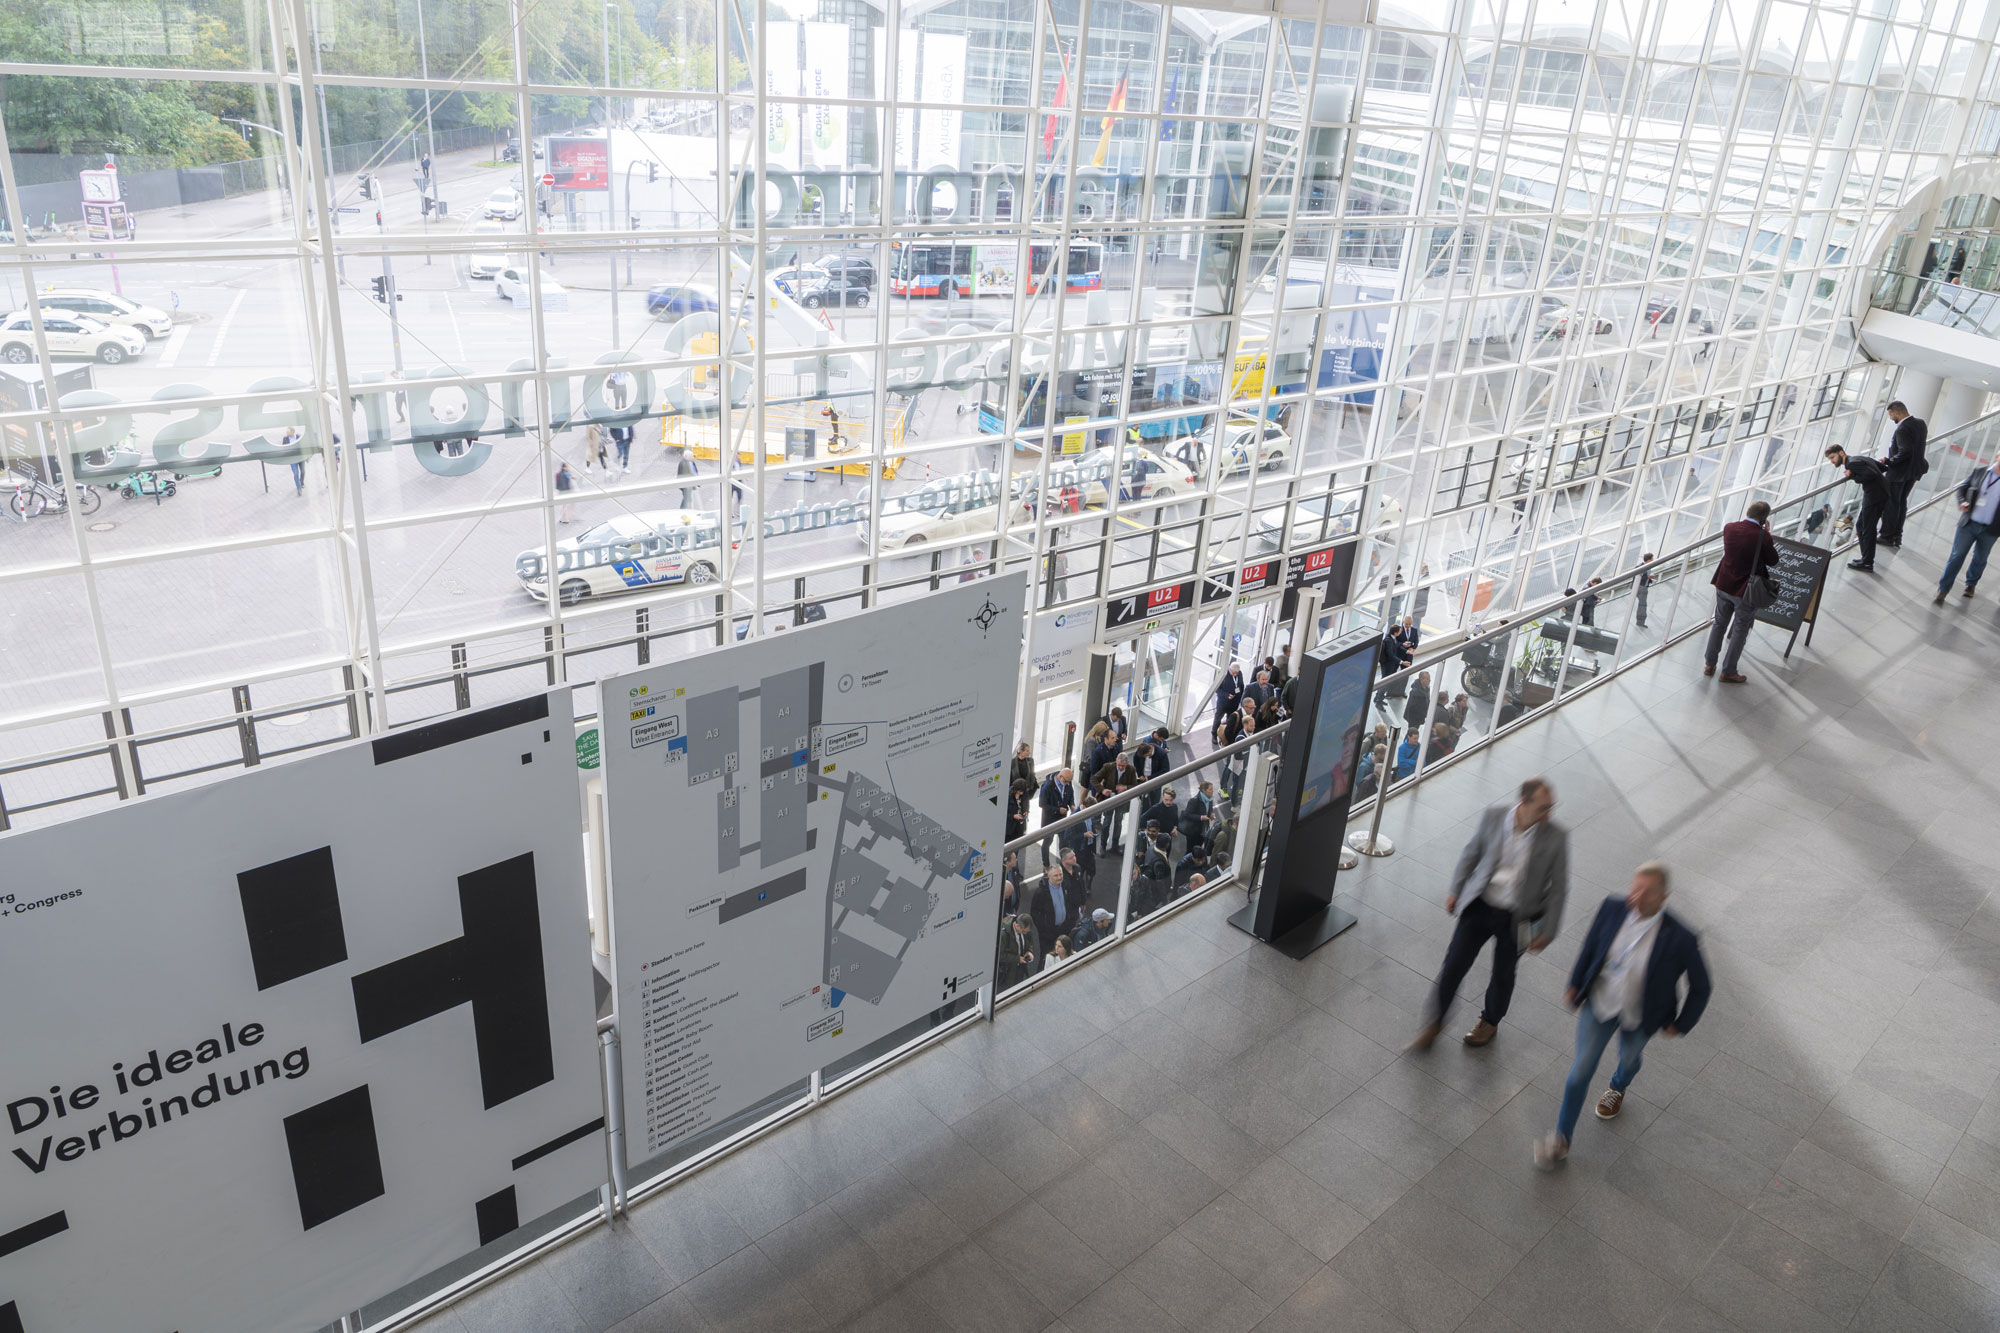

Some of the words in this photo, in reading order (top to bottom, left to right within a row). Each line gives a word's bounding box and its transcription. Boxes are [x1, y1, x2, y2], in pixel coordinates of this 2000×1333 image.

[1193, 365, 1216, 375] 100%
[1312, 554, 1327, 567] U2
[1245, 566, 1260, 580] U2
[1155, 587, 1174, 602] U2
[631, 709, 645, 719] TAXI
[778, 706, 790, 718] A4
[635, 725, 657, 736] Eingang
[658, 721, 672, 729] West
[706, 728, 720, 740] A3
[635, 736, 649, 744] West
[651, 729, 674, 740] Entrance
[856, 788, 865, 797] B1
[777, 808, 790, 819] A1
[722, 827, 735, 839] A2
[851, 875, 861, 886] B7
[15, 886, 83, 914] Congress
[689, 902, 709, 914] Parkhaus
[903, 903, 912, 913] B5
[651, 955, 672, 967] Standort
[694, 941, 705, 949] here
[850, 962, 860, 972] B6
[652, 969, 680, 984] Information
[652, 976, 686, 994] Hallenmeister
[653, 989, 679, 1004] Restaurant
[671, 996, 685, 1006] Snack
[653, 1010, 677, 1024] Konferenz
[680, 997, 707, 1012] Conference
[654, 1022, 675, 1033] Toiletten
[719, 992, 738, 1004] disabled
[654, 1032, 675, 1043] Toiletten
[677, 1020, 701, 1033] Lavatories
[654, 1037, 684, 1053] Wickelraum
[655, 1055, 667, 1063] Erste
[668, 1049, 680, 1057] Hilfe
[655, 1060, 677, 1073] Business
[678, 1052, 693, 1062] Center
[6, 1081, 100, 1136] Die
[112, 1020, 266, 1096] ideale
[670, 1067, 681, 1076] Club
[656, 1086, 681, 1101] Garderobe
[11, 1045, 312, 1176] Verbindung
